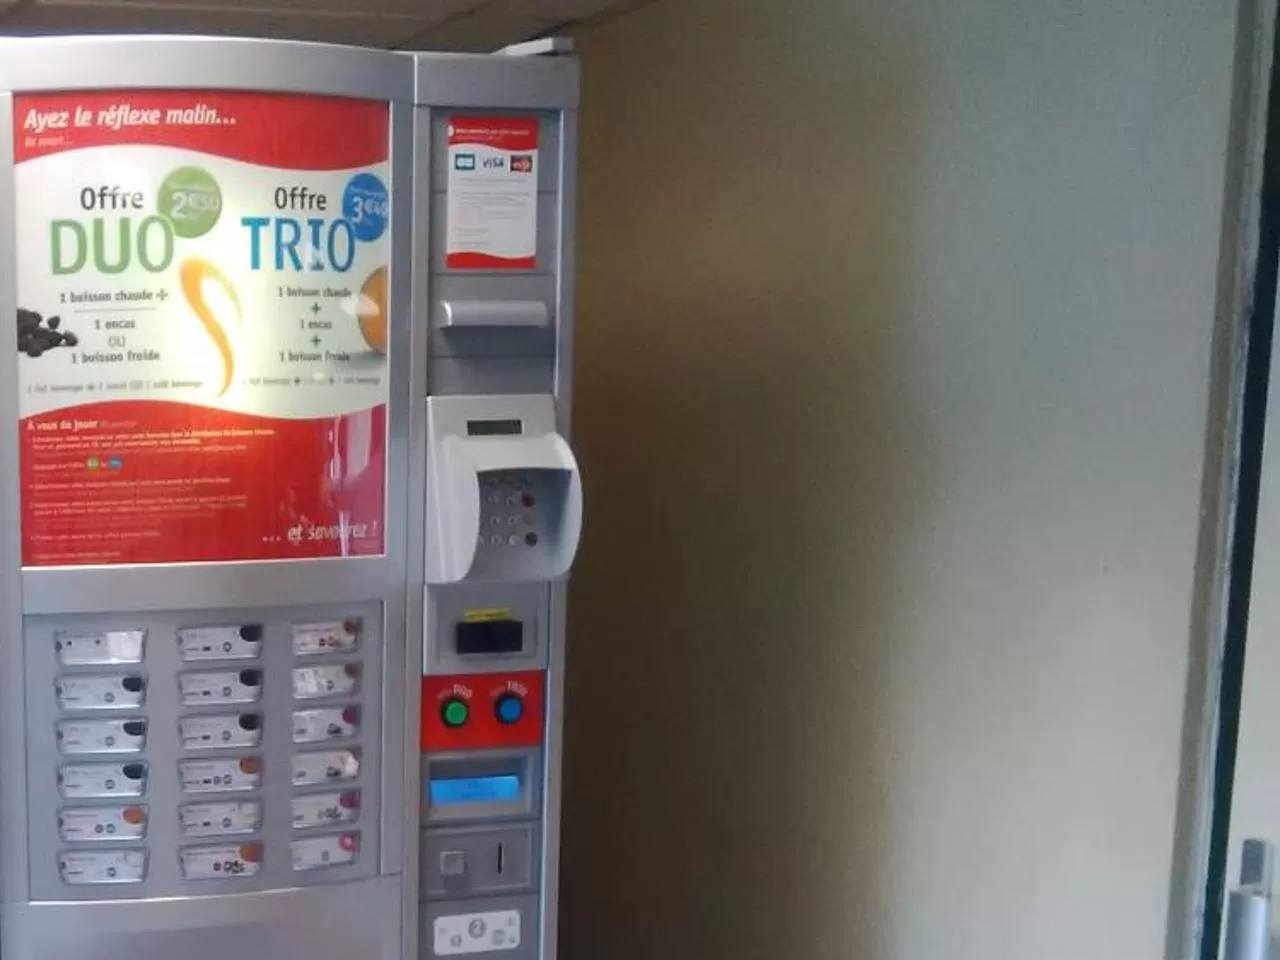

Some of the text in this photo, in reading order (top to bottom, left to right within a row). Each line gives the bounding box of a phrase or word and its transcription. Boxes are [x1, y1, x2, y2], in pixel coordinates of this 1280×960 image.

[24, 108, 69, 133] Ayez
[75, 106, 91, 127] le
[97, 105, 161, 130] réflexe
[483, 158, 504, 168] VISA
[80, 186, 144, 211] Offre
[274, 187, 328, 211] Offre
[50, 215, 174, 276] DUO
[241, 217, 356, 272] TRIO
[70, 291, 111, 303] boisson
[115, 288, 153, 302] chaude
